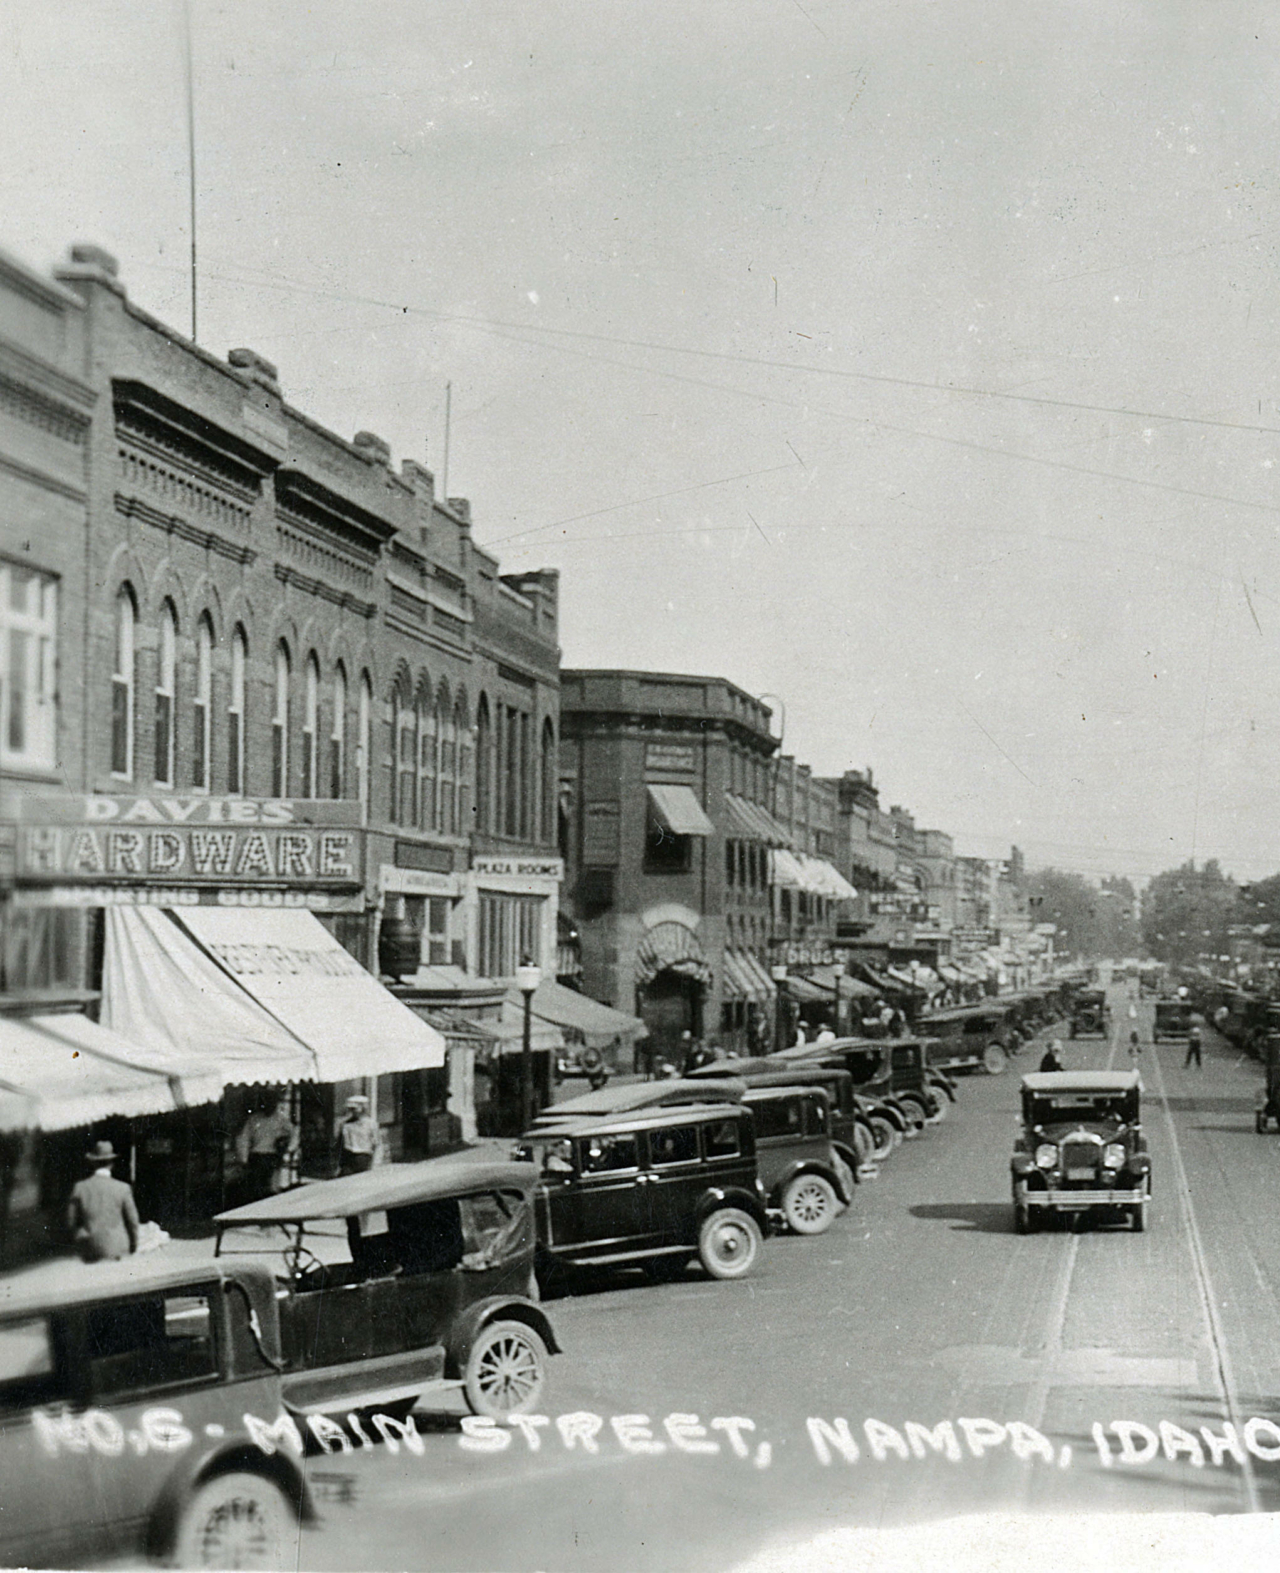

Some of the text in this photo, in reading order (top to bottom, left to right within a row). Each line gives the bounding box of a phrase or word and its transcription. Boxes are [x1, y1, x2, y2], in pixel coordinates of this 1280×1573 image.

[85, 798, 295, 822] DAVIES
[26, 829, 354, 875] HARDWARE
[477, 862, 559, 876] PLAZA ROOMS
[217, 890, 330, 909] GOODS
